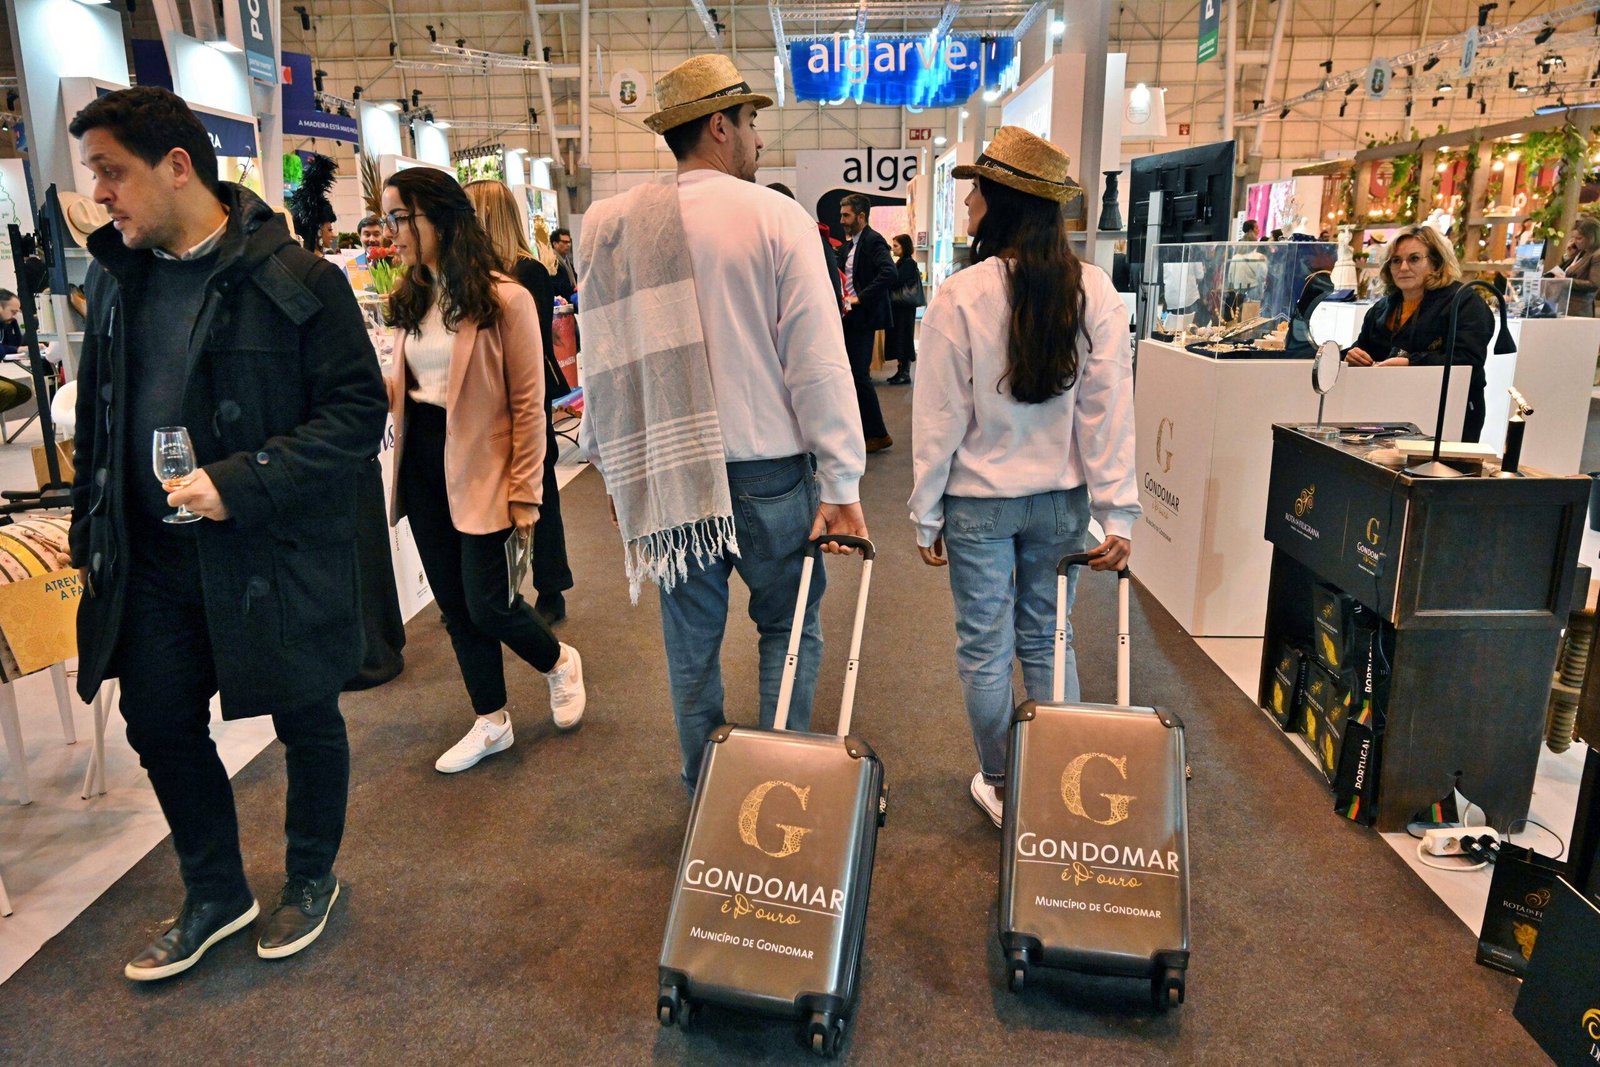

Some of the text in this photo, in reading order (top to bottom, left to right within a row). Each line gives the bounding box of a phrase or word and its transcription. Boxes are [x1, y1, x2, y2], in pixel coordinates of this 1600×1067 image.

[807, 31, 978, 84] algarve.
[1144, 472, 1180, 512] GONDOMAR
[1357, 541, 1379, 561] GONDOM
[61, 590, 69, 600] A
[1354, 739, 1371, 790] PORTUGAL
[1060, 752, 1137, 826] G
[738, 780, 812, 858] G
[1017, 832, 1179, 872] GONDOMAR
[685, 859, 845, 912] GONDOMAR
[1035, 895, 1162, 919] MUNICÍPIO DE GONDOMAR
[1503, 900, 1525, 913] ROTA
[690, 926, 814, 960] MUNICÍPIO DE GONDOMAR
